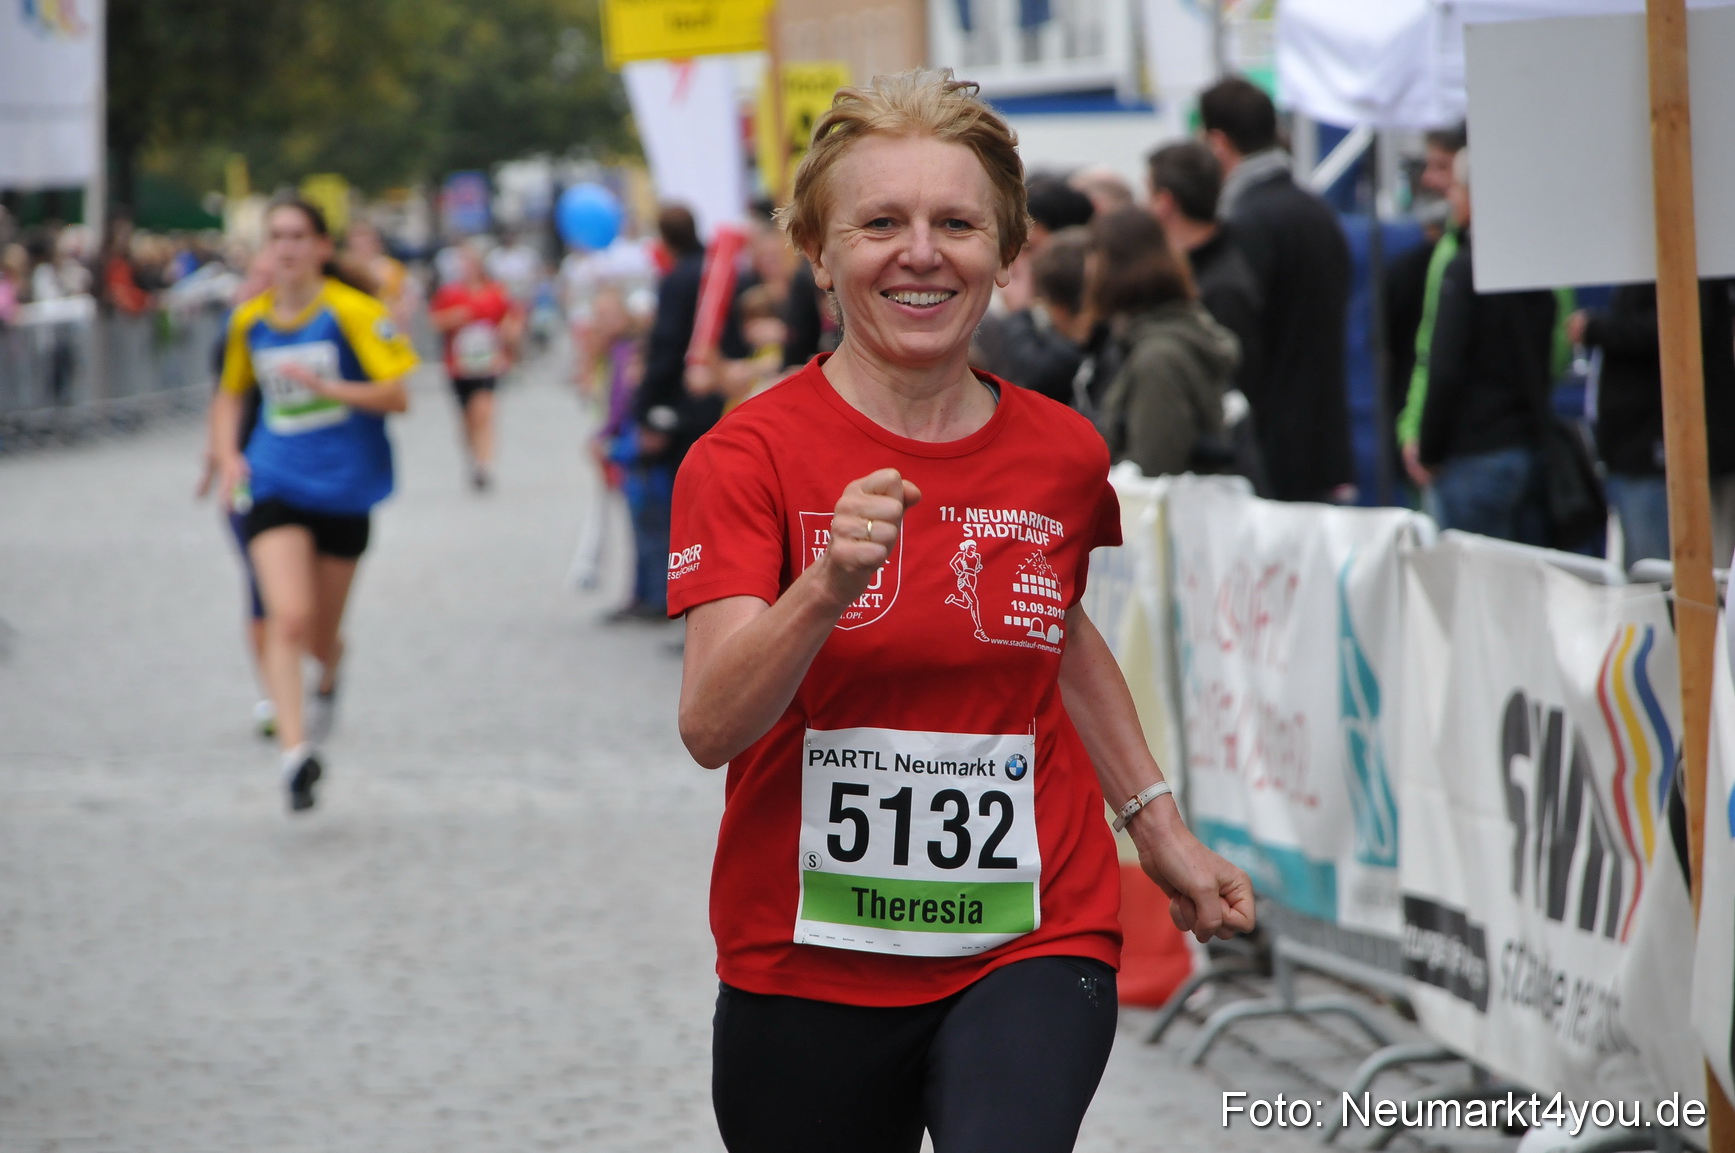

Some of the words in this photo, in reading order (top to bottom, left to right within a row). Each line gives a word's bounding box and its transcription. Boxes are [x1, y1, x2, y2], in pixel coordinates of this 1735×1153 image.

[939, 506, 962, 522] 11.
[966, 507, 1064, 538] NEUMARKTER
[962, 523, 1050, 547] STADTLAUF
[808, 749, 888, 771] PARTL
[895, 754, 996, 777] Neumarkt
[826, 782, 1018, 870] 5132
[808, 854, 817, 868] S
[851, 886, 983, 924] Theresia
